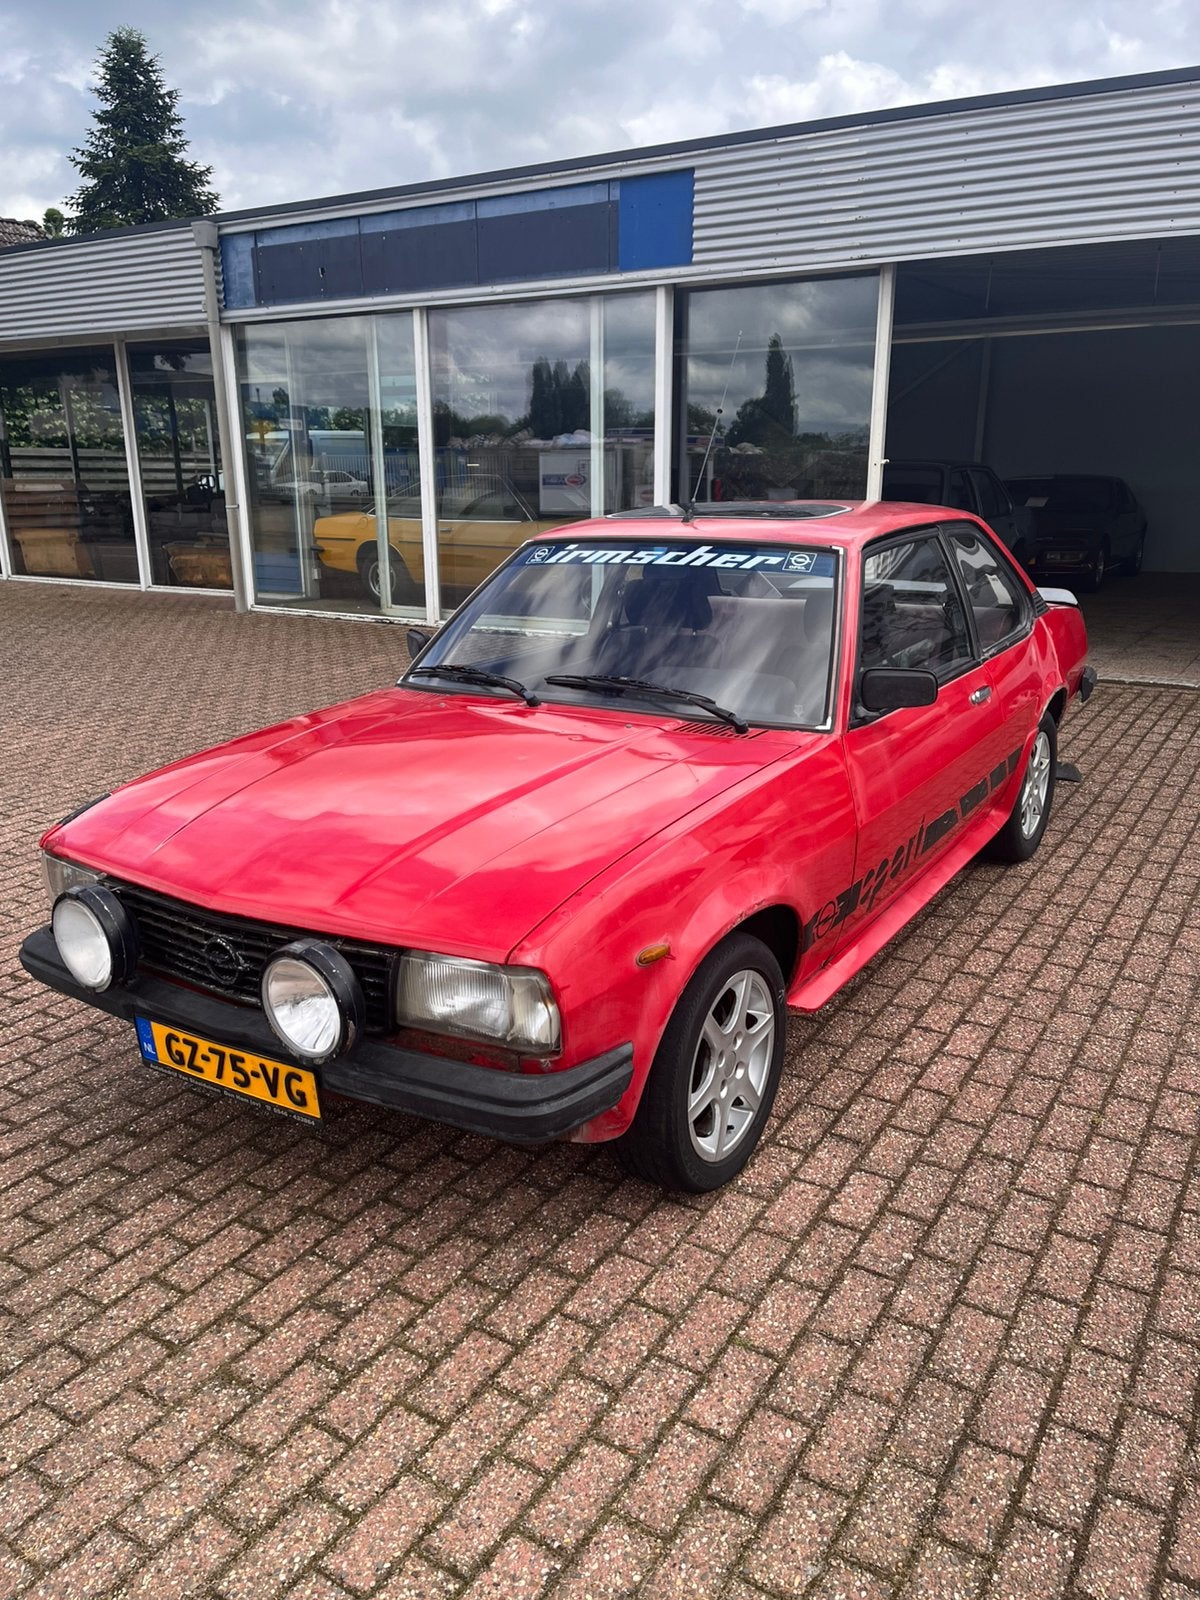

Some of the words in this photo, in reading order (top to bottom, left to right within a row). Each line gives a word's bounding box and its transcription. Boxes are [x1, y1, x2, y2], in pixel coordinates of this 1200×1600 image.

[545, 544, 786, 569] irmscher
[143, 1041, 156, 1055] NL
[164, 1032, 308, 1108] GZ-75-VG
